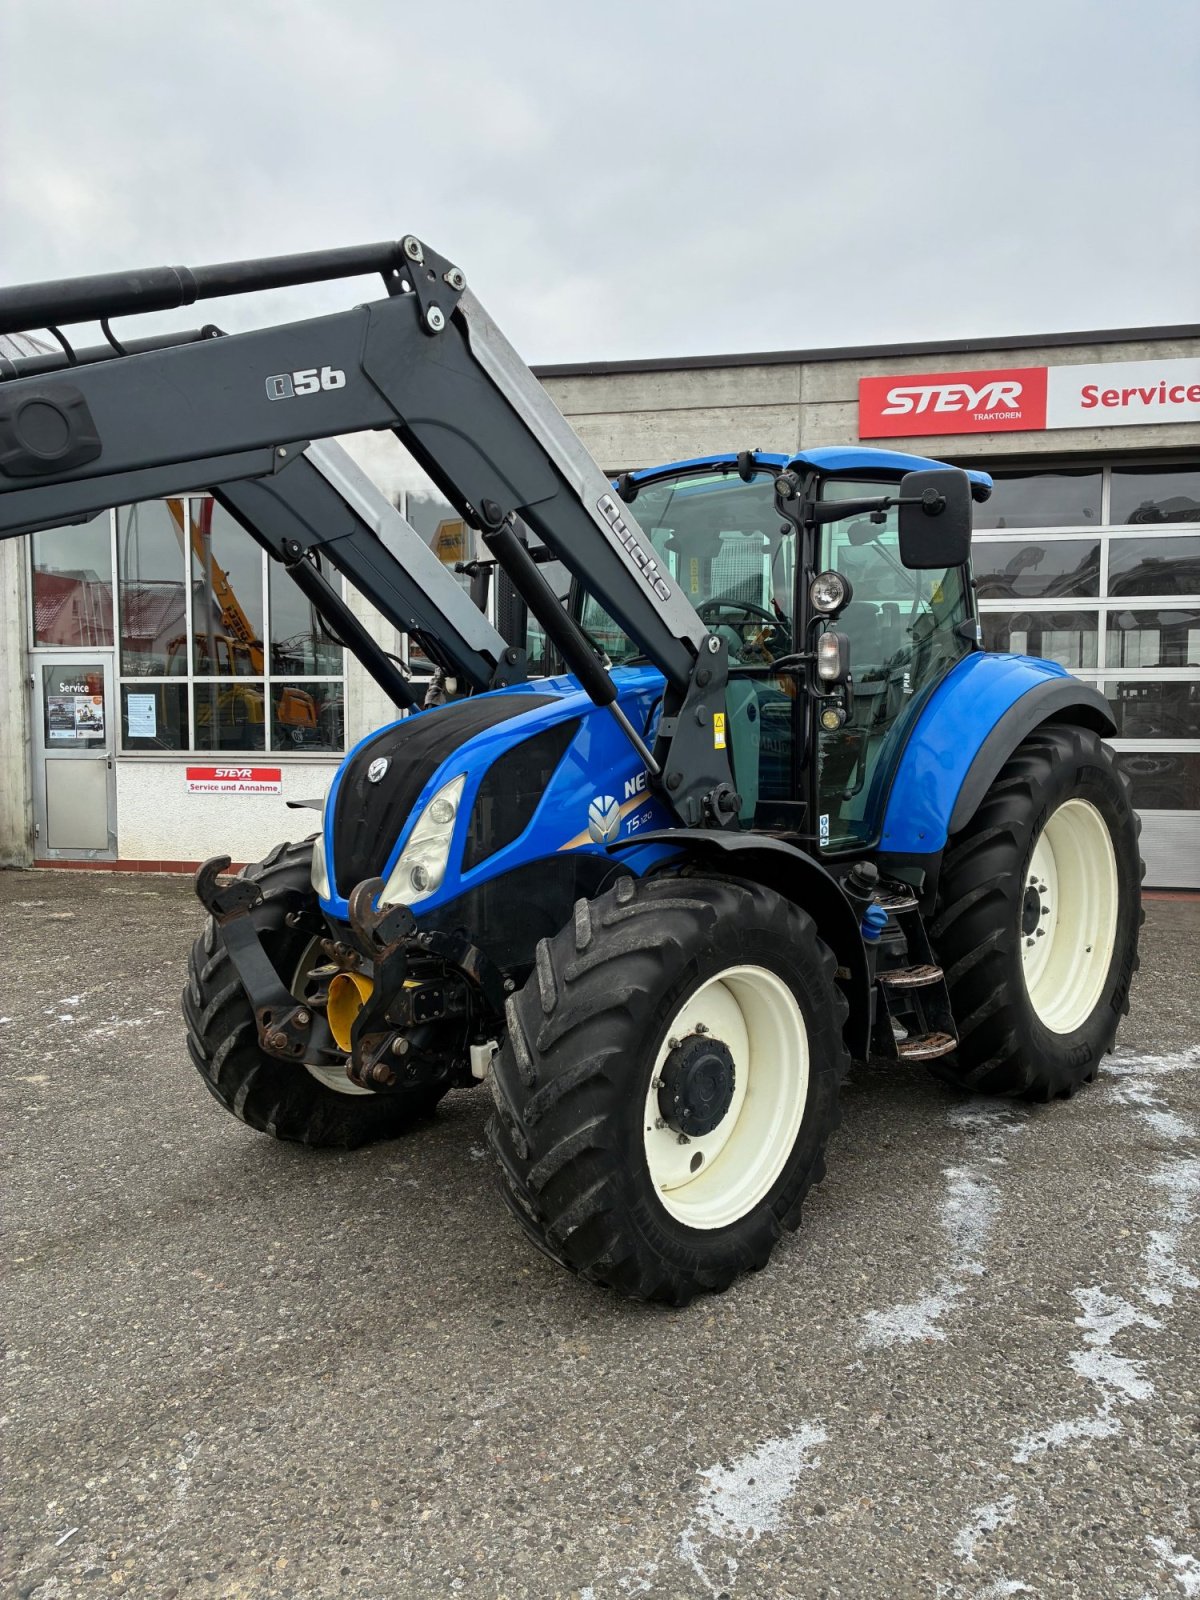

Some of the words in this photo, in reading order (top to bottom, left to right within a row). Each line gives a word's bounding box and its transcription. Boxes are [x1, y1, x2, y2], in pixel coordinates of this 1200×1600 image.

[265, 366, 346, 401] Q56
[1081, 380, 1200, 408] Service
[881, 381, 1023, 415] STEYR
[973, 411, 1022, 421] TRAKTOREN
[596, 493, 672, 602] Quicke
[59, 682, 90, 693] Service
[214, 768, 252, 778] STEYR
[624, 770, 648, 799] NE
[190, 783, 219, 791] Service
[239, 784, 278, 792] Annahme
